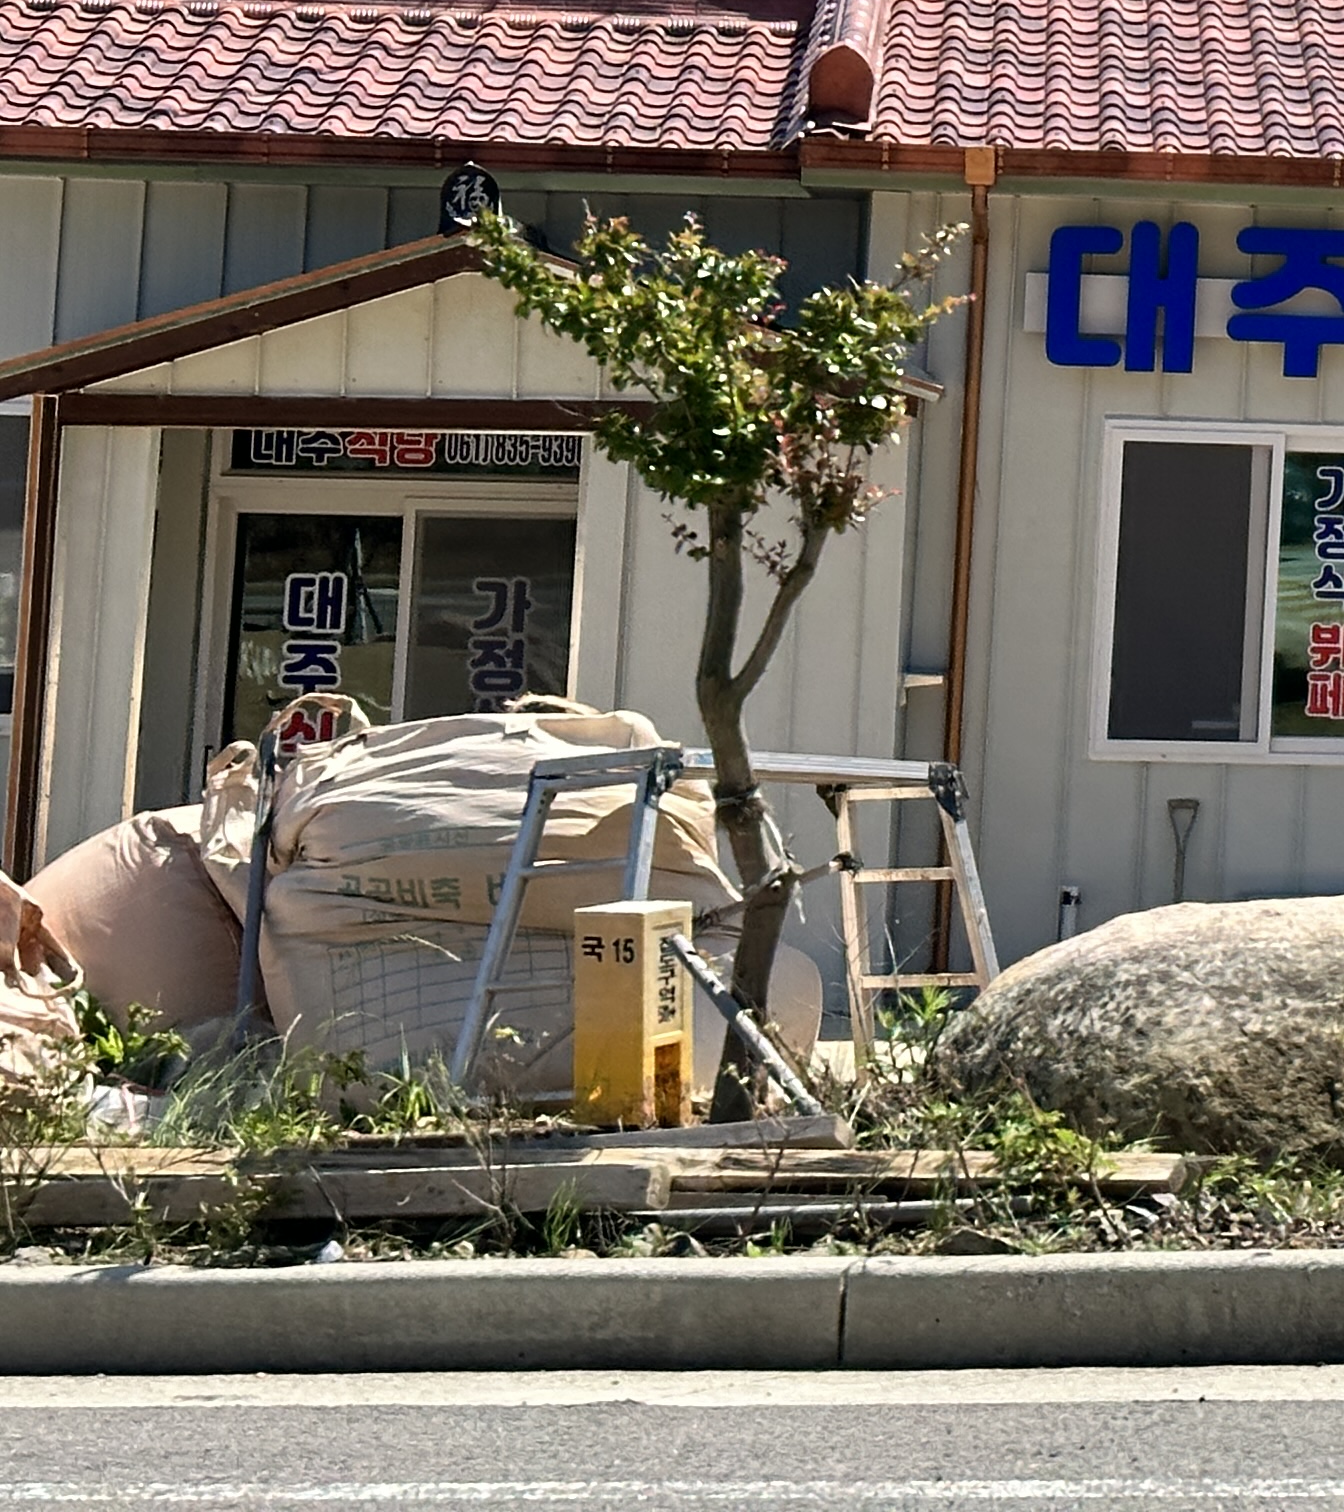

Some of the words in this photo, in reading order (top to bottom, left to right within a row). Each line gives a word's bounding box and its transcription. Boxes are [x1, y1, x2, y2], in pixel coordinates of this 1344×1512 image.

[444, 432, 580, 466] 061)835-939
[468, 576, 534, 713] 가정
[581, 935, 606, 963] 국
[611, 937, 635, 964] 15
